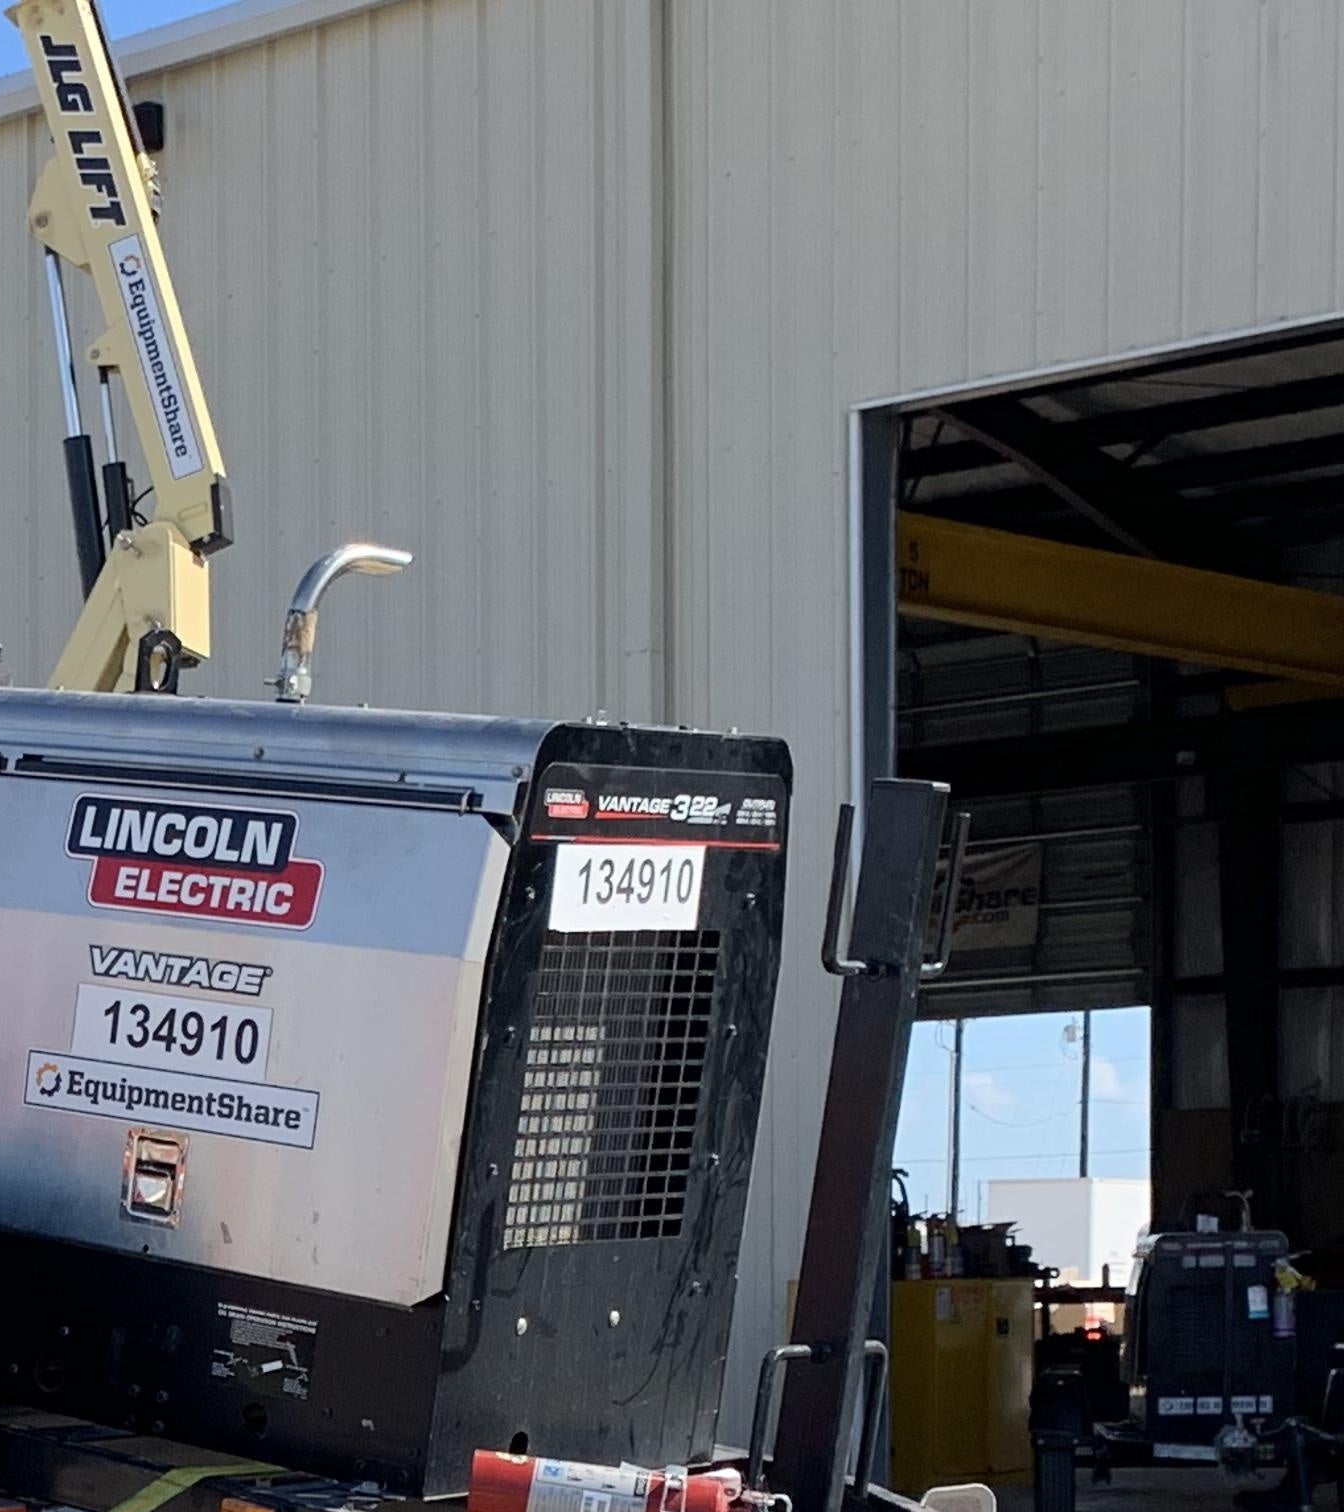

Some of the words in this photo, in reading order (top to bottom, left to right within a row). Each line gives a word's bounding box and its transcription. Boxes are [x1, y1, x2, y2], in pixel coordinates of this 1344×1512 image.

[40, 35, 94, 113] JLG
[68, 131, 126, 228] LIFT
[128, 278, 187, 458] EquipmentShare
[79, 805, 284, 867] LINCOLN
[598, 795, 671, 814] VANTAGE
[670, 794, 719, 821] 322
[114, 867, 294, 916] ELECTRIC
[578, 857, 695, 905] 134910
[89, 944, 268, 996] VANTAGE
[103, 1000, 259, 1065] 134910
[66, 1070, 302, 1131] EquipmentShare
